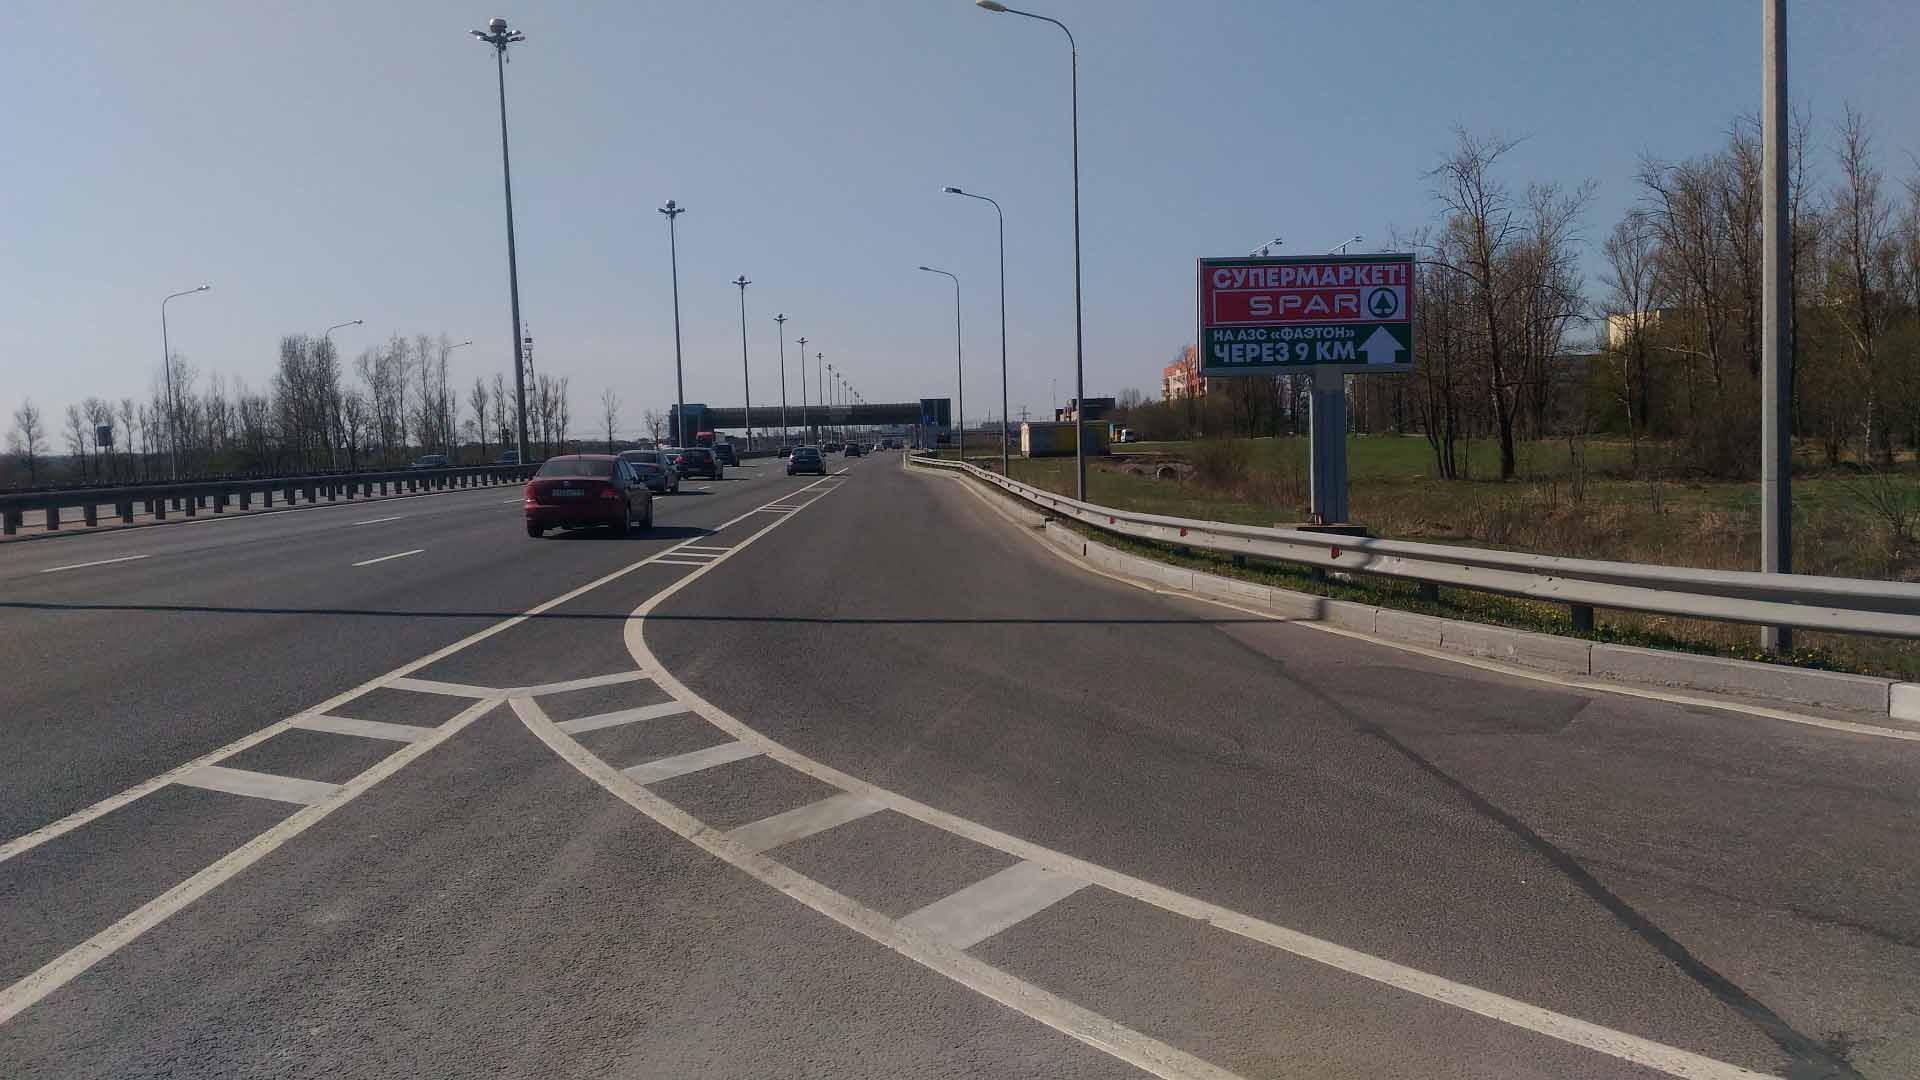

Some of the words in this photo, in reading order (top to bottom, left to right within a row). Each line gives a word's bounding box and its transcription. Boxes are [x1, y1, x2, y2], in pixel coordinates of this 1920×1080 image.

[1213, 264, 1406, 288] СУПЕРМАРКЕТ!
[1249, 294, 1359, 316] SPAR
[1214, 330, 1233, 341] НА
[1238, 329, 1267, 340] АЗС
[1270, 327, 1355, 340] «ФАЭТОН»
[1214, 343, 1290, 363] ЧЕРЕЗ
[1295, 343, 1310, 361] 9
[1316, 341, 1356, 360] КМ
